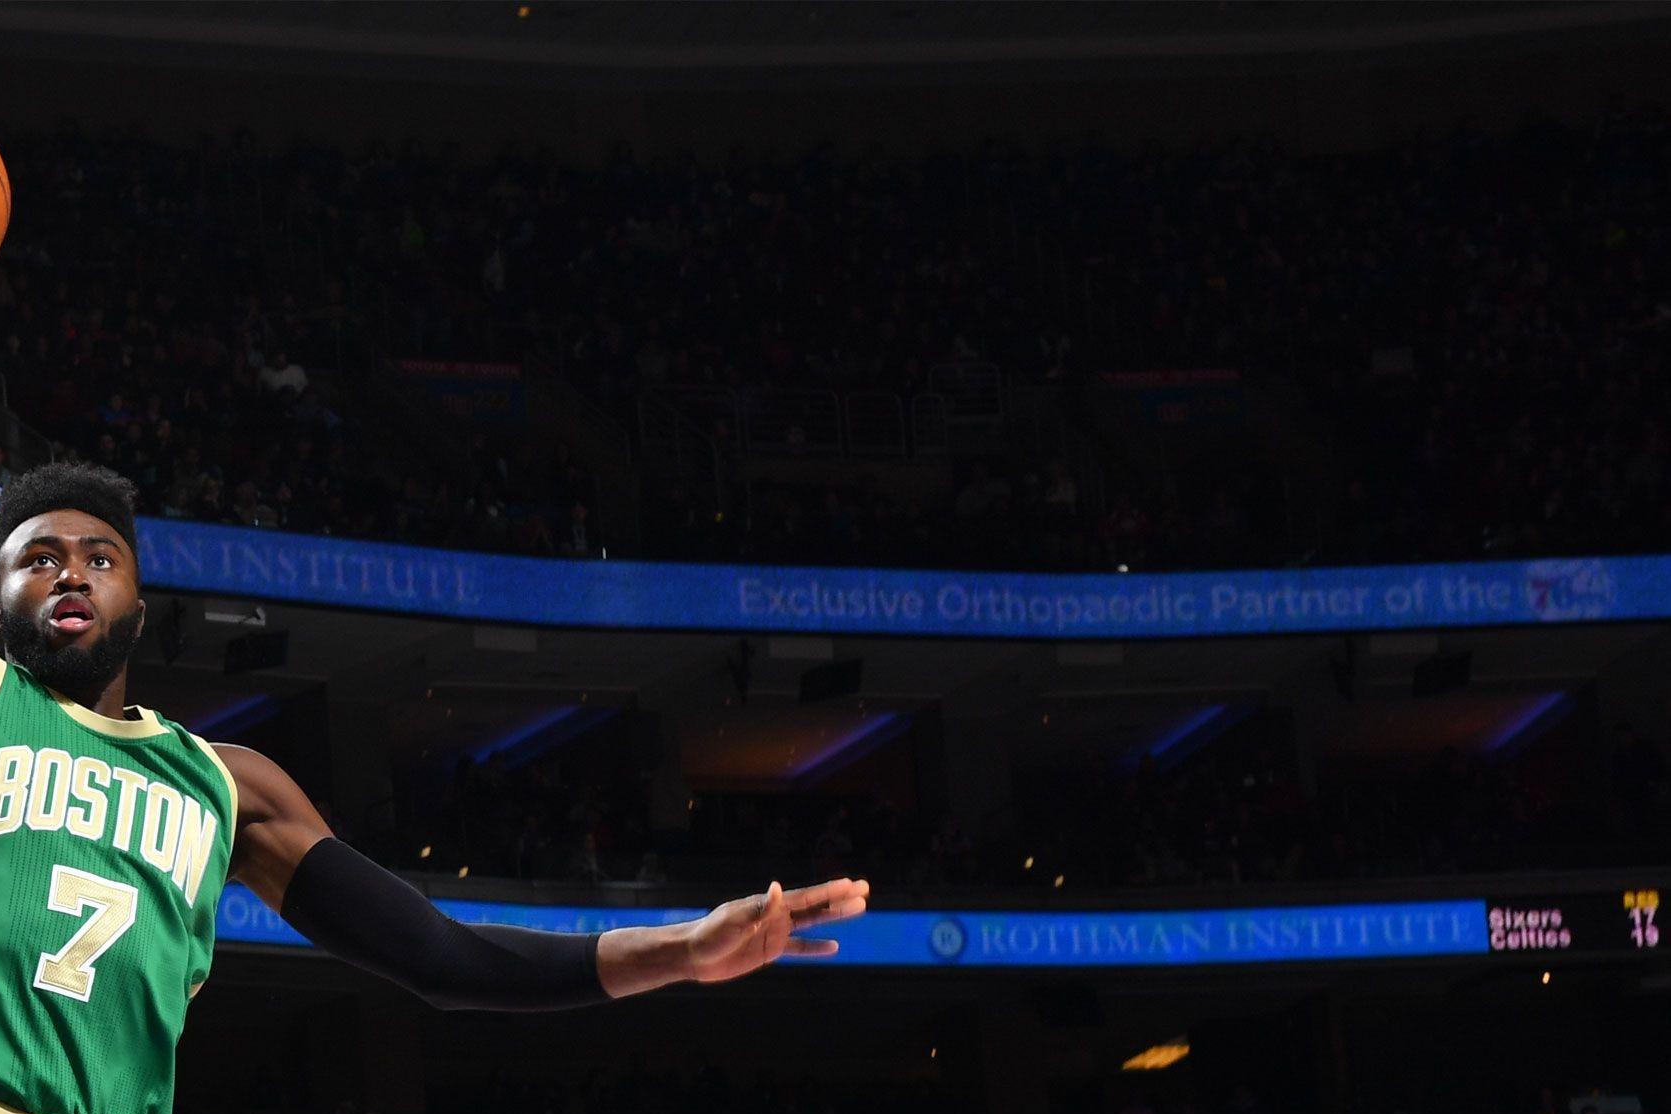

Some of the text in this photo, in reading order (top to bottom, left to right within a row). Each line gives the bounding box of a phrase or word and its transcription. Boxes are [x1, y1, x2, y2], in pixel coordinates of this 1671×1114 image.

[738, 578, 925, 618] Exclusive
[936, 584, 1197, 632] Orthopaedic
[1210, 584, 1369, 619] Partner
[1385, 577, 1429, 614] of
[1441, 576, 1511, 611] the
[33, 864, 138, 1002] 7
[981, 917, 1211, 957] ROTHMAN
[1230, 909, 1471, 951] INSTITUTE
